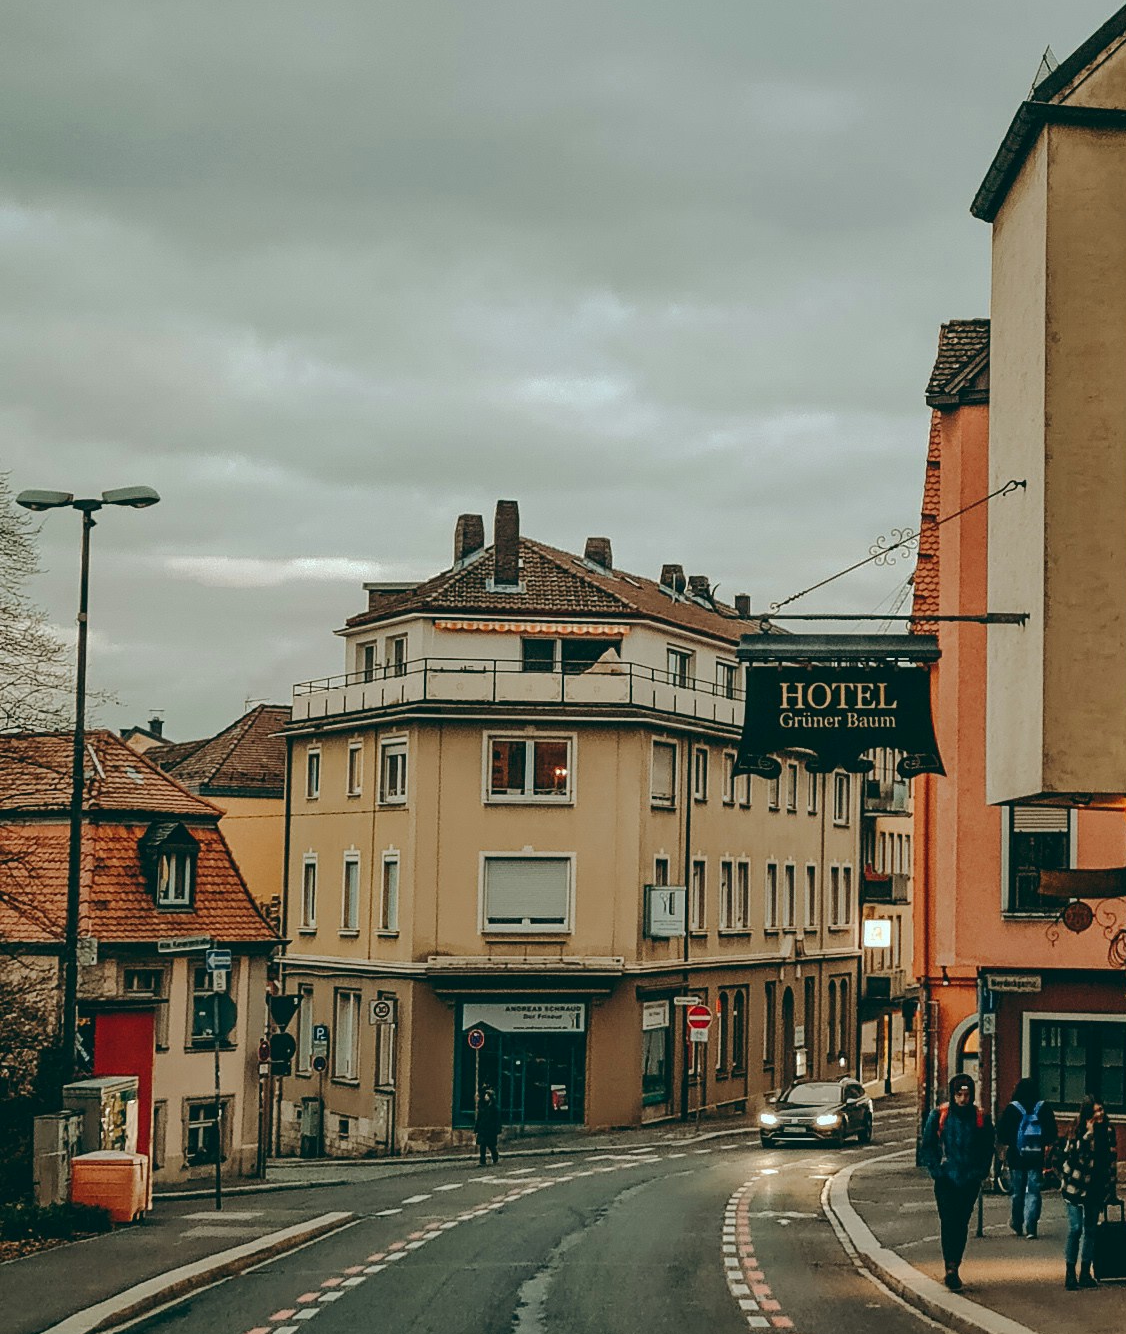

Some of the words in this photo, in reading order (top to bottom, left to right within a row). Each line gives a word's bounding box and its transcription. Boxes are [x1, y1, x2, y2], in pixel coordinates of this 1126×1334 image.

[779, 682, 898, 709] HOTEL
[779, 712, 842, 728] Grüner
[847, 712, 897, 728] Baum
[317, 1028, 324, 1039] P
